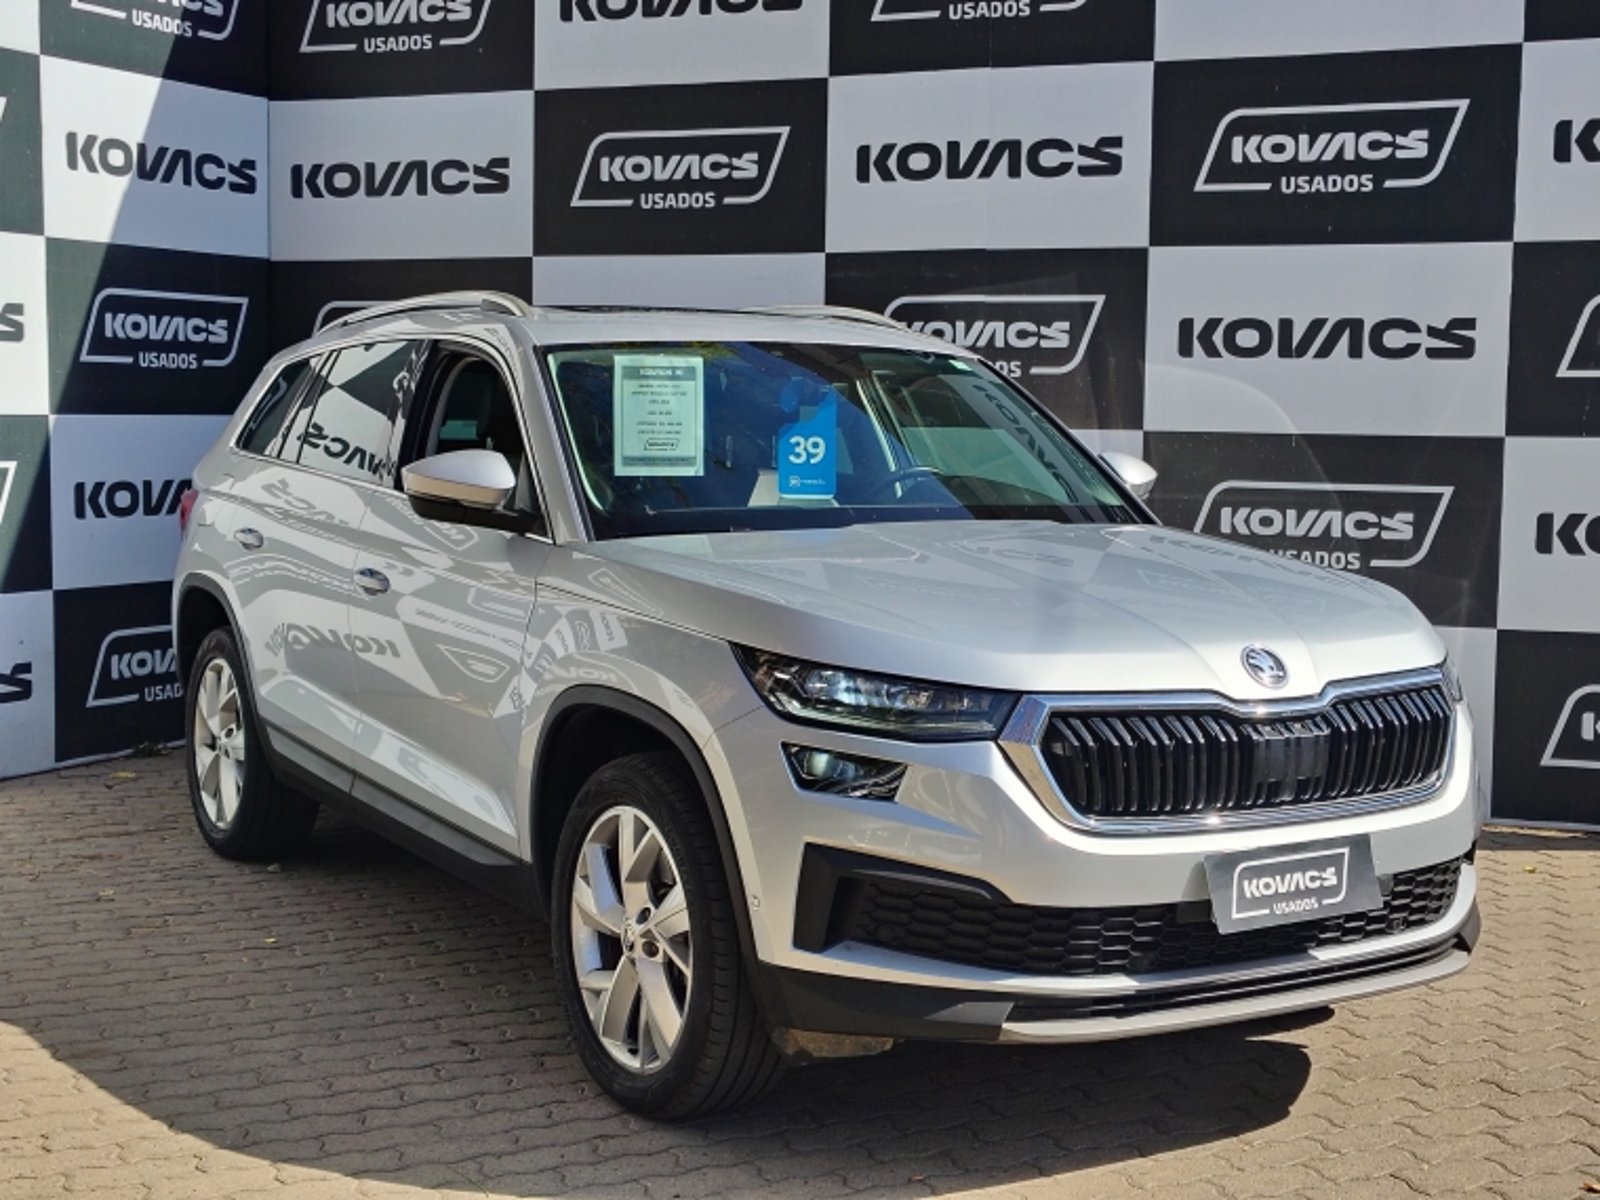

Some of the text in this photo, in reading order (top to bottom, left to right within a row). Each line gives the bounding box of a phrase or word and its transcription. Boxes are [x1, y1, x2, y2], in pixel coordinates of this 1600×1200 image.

[131, 9, 192, 37] USADOS
[326, 0, 472, 28] KOVACS
[949, 0, 1031, 20] USADOS
[363, 34, 433, 53] USADOS
[857, 136, 1123, 183] KOVACS
[1231, 130, 1429, 164] KOVACS
[66, 131, 257, 195] KOVACS
[600, 152, 759, 182] KOVACS
[291, 157, 510, 199] KOVACS
[1281, 174, 1374, 193] USADOS
[640, 191, 715, 209] USADOS
[104, 312, 228, 343] KOVACS
[901, 320, 1070, 349] OVACS
[1178, 318, 1477, 360] KOVACS
[138, 351, 198, 369] USADOS
[789, 435, 826, 464] 39
[1220, 506, 1414, 541] KOVACS
[1242, 866, 1338, 899] KOVACS
[1272, 896, 1319, 915] USADOS
